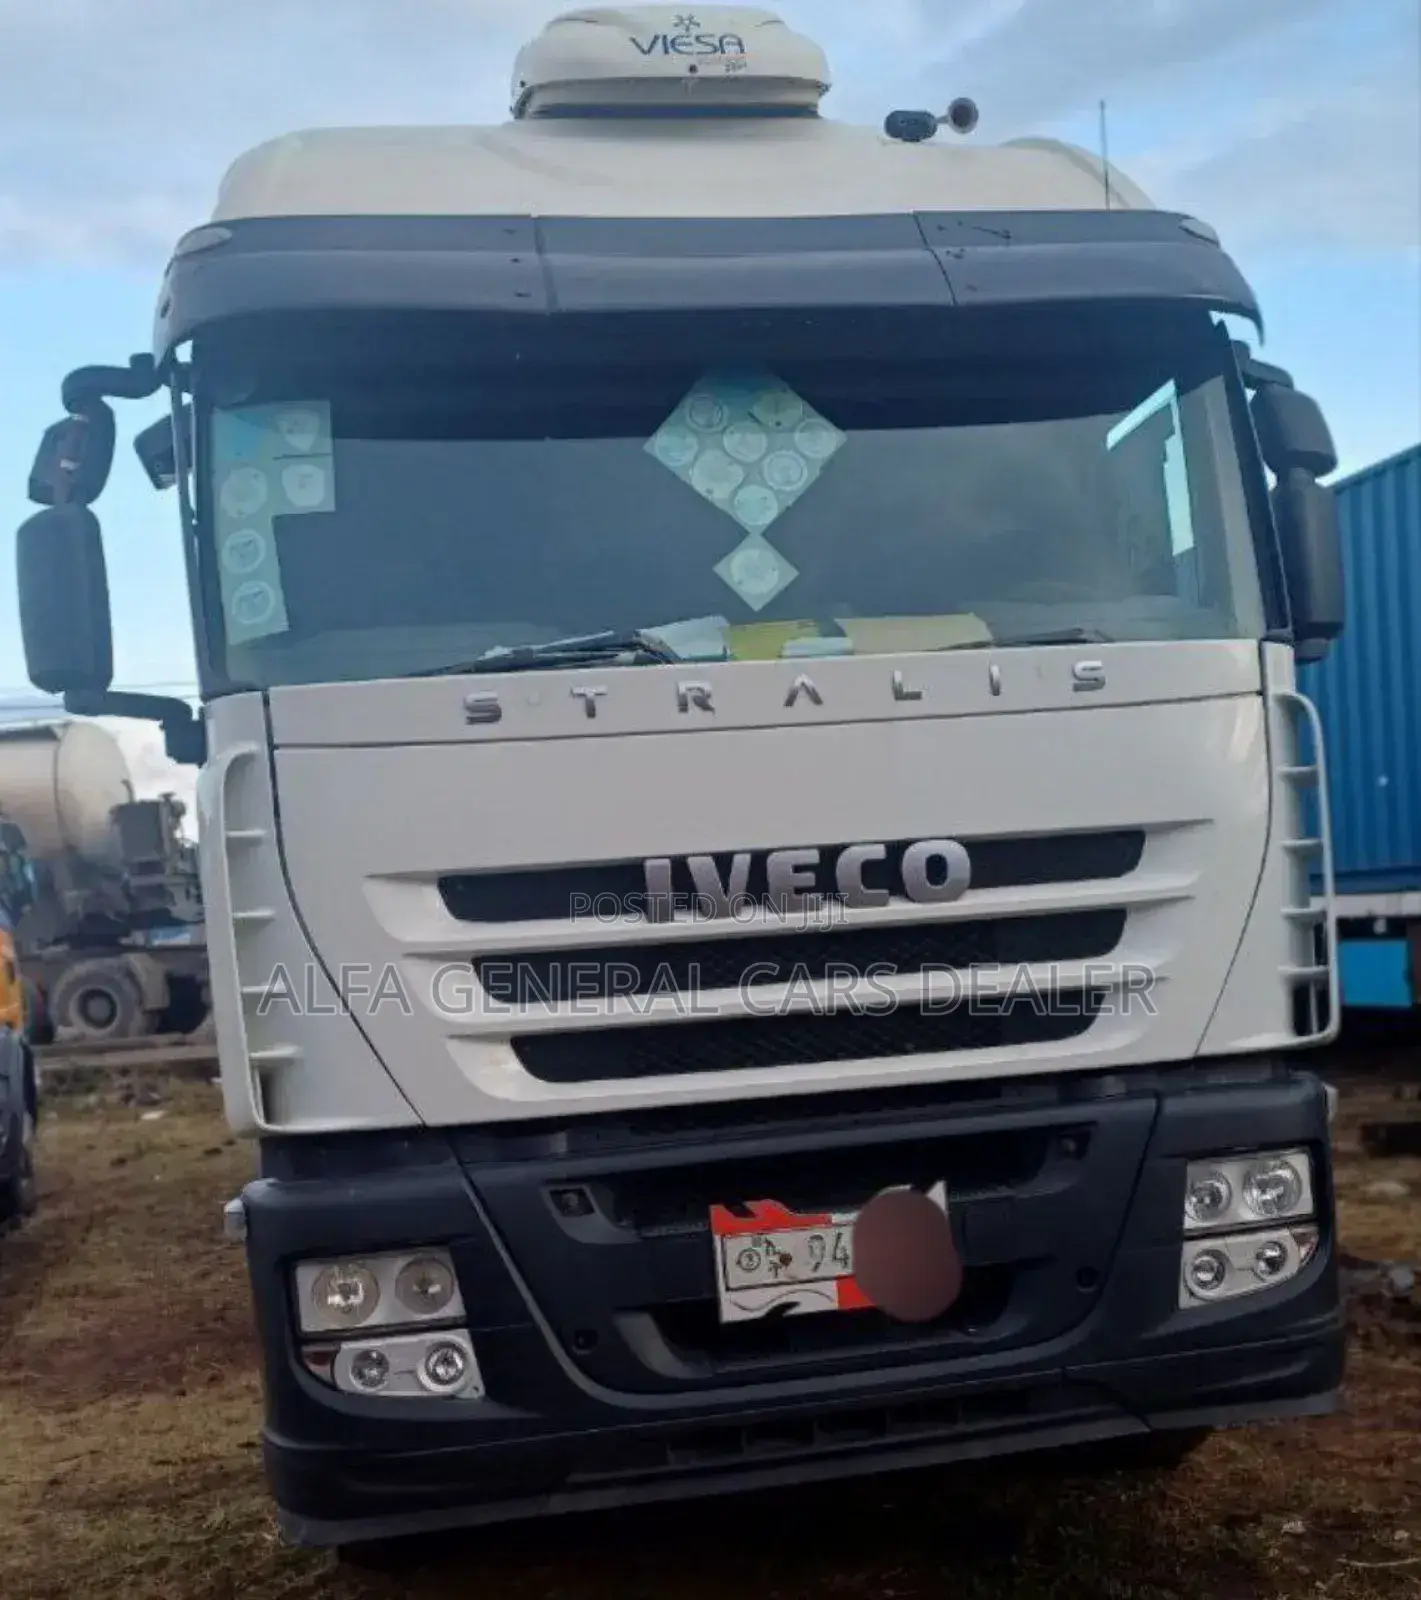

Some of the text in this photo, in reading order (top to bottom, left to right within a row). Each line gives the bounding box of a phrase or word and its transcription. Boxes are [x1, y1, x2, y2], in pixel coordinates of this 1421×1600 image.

[629, 34, 746, 55] VIESA
[465, 660, 1107, 725] STRALIS
[643, 838, 972, 924] IVECO
